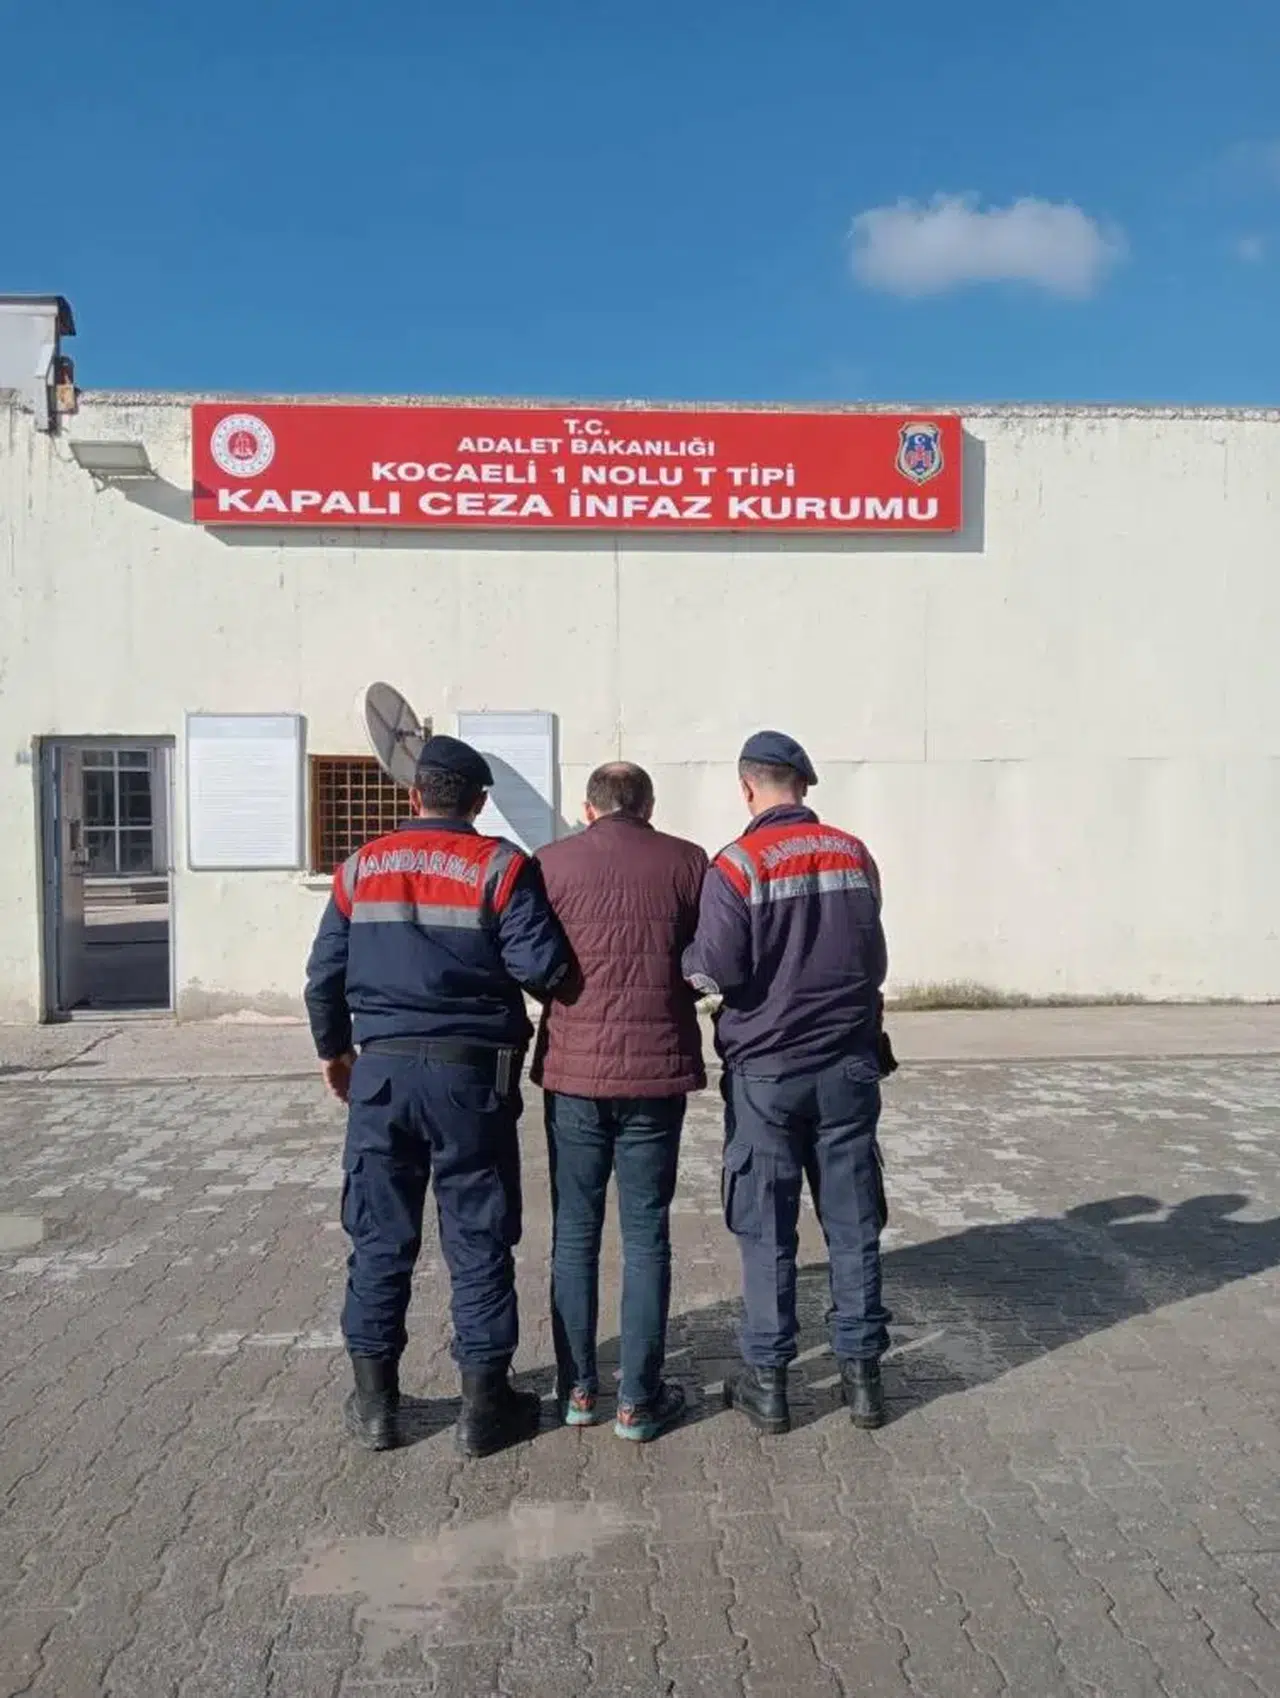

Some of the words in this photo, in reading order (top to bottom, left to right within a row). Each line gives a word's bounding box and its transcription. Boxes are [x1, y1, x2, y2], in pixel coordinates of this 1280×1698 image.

[564, 418, 611, 436] T.C.
[458, 438, 563, 454] ADALET
[570, 437, 715, 456] BAKANLIĞI
[371, 460, 537, 484] KOCAELİ
[551, 466, 566, 484] 1
[580, 466, 682, 486] NOLU
[693, 468, 717, 486] T
[726, 463, 795, 487] TİPİ
[218, 489, 401, 515] KAPALI
[418, 492, 553, 517] CEZA
[569, 488, 712, 518] İNFAZ
[728, 496, 938, 520] KURUMU
